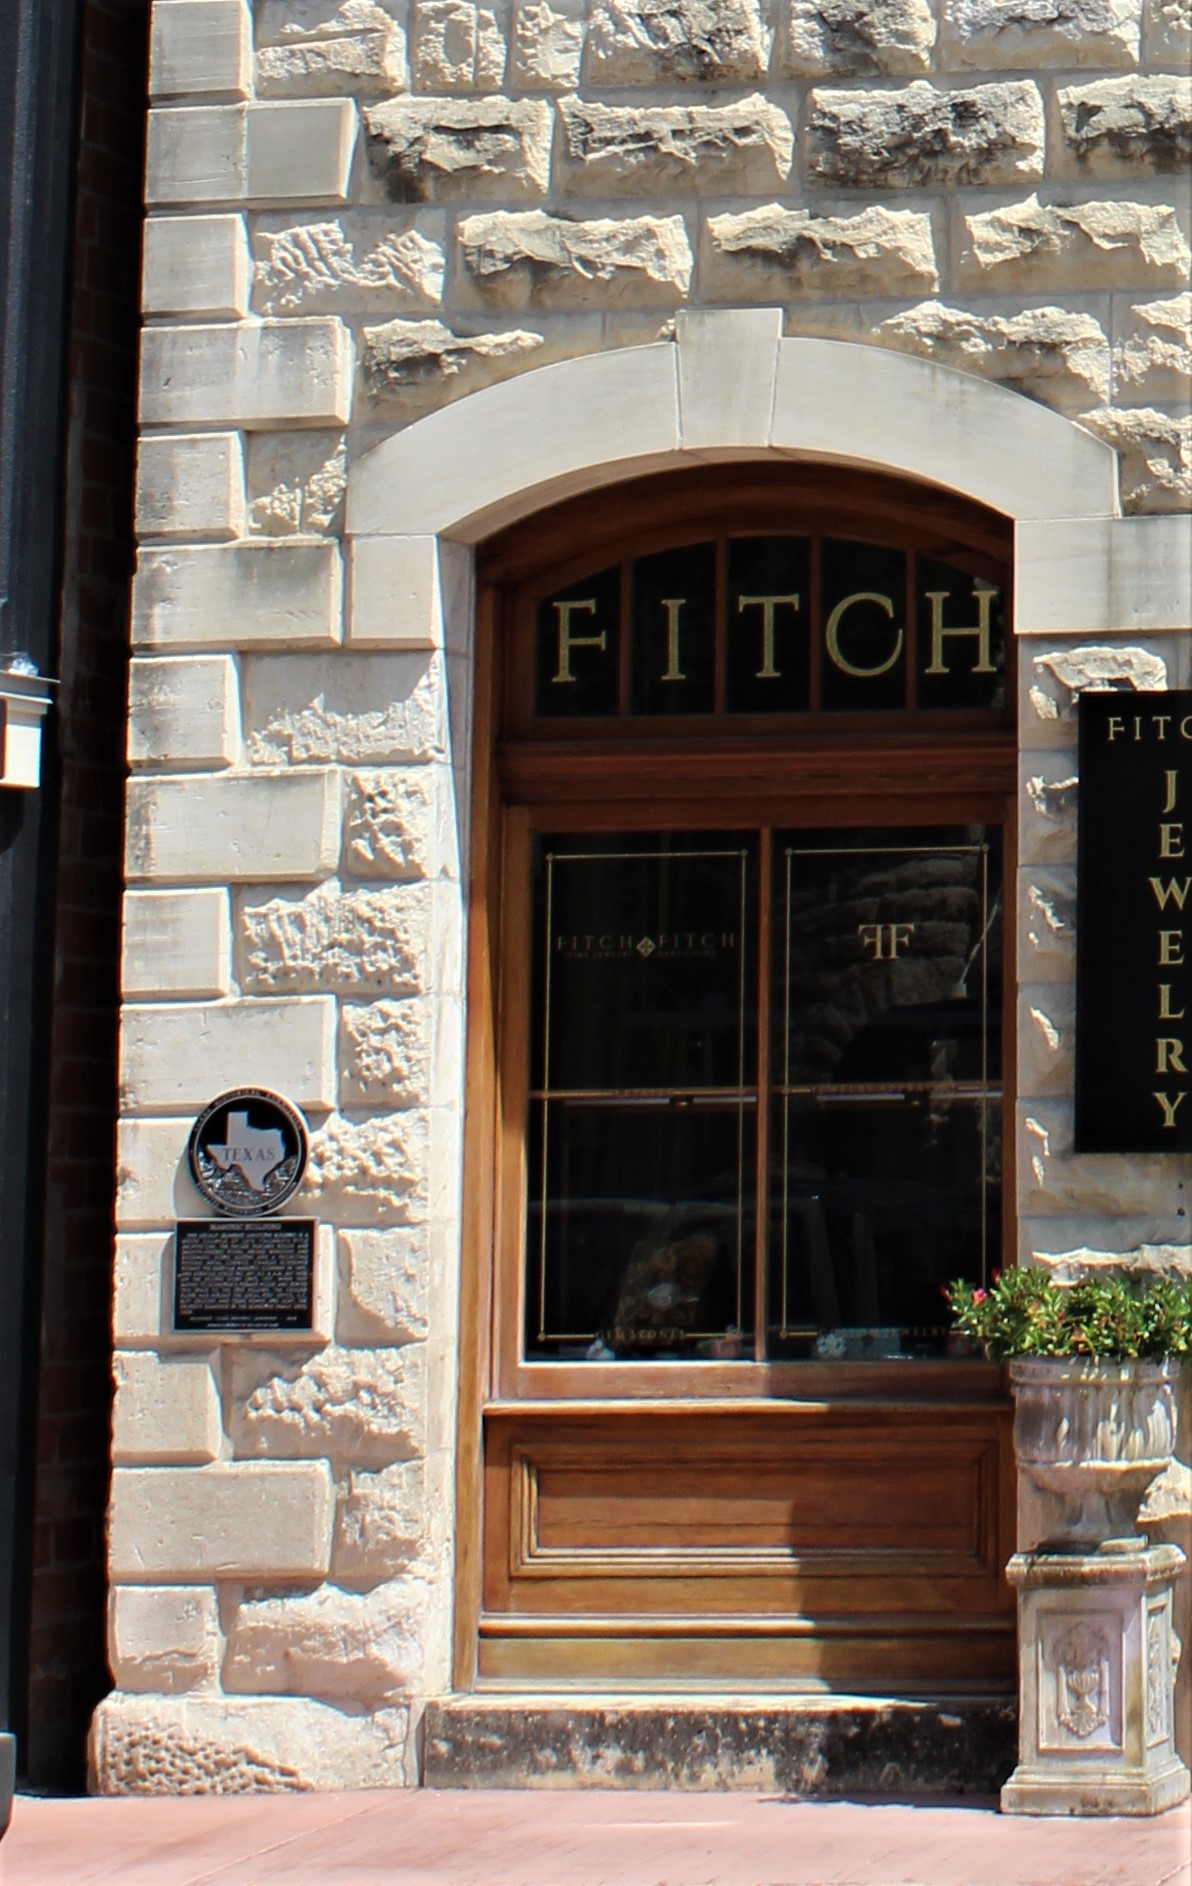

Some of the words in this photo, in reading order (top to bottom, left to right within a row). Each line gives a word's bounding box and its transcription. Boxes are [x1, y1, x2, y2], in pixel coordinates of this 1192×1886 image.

[551, 590, 998, 683] FITCH
[556, 935, 632, 951] FITCH
[659, 932, 735, 949] FITCH
[1148, 769, 1192, 1127] JEWELRY
[222, 1147, 275, 1161] TEXAS
